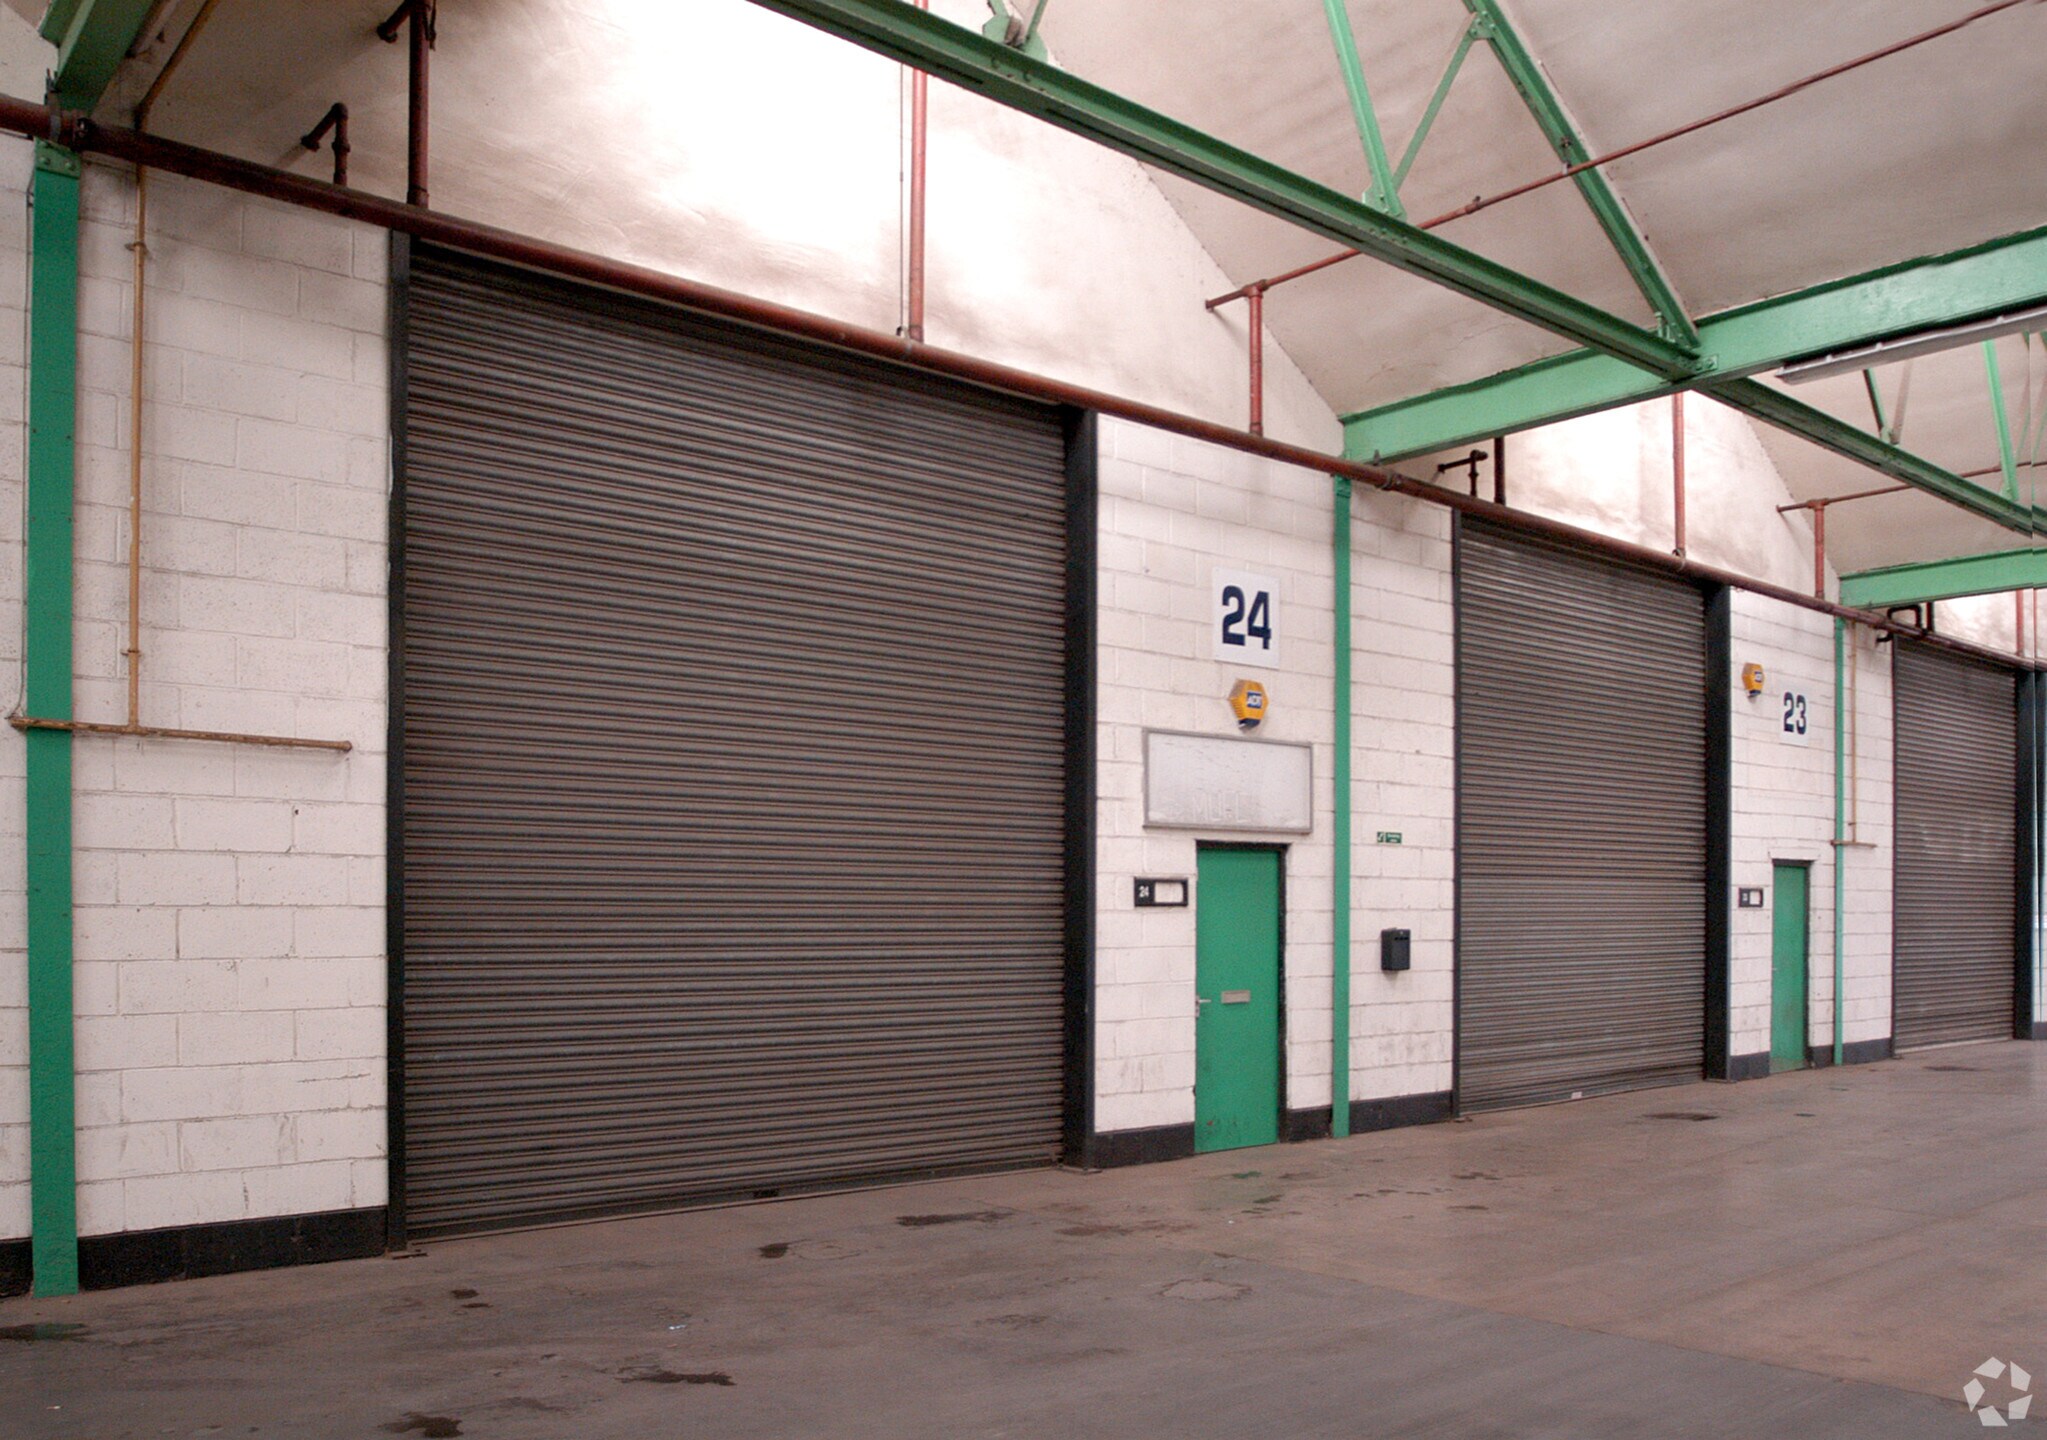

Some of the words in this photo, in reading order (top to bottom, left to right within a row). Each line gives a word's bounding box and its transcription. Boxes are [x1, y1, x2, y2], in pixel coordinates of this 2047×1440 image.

[1222, 585, 1272, 650] 24
[1783, 691, 1807, 735] 23
[1138, 885, 1150, 898] 24
